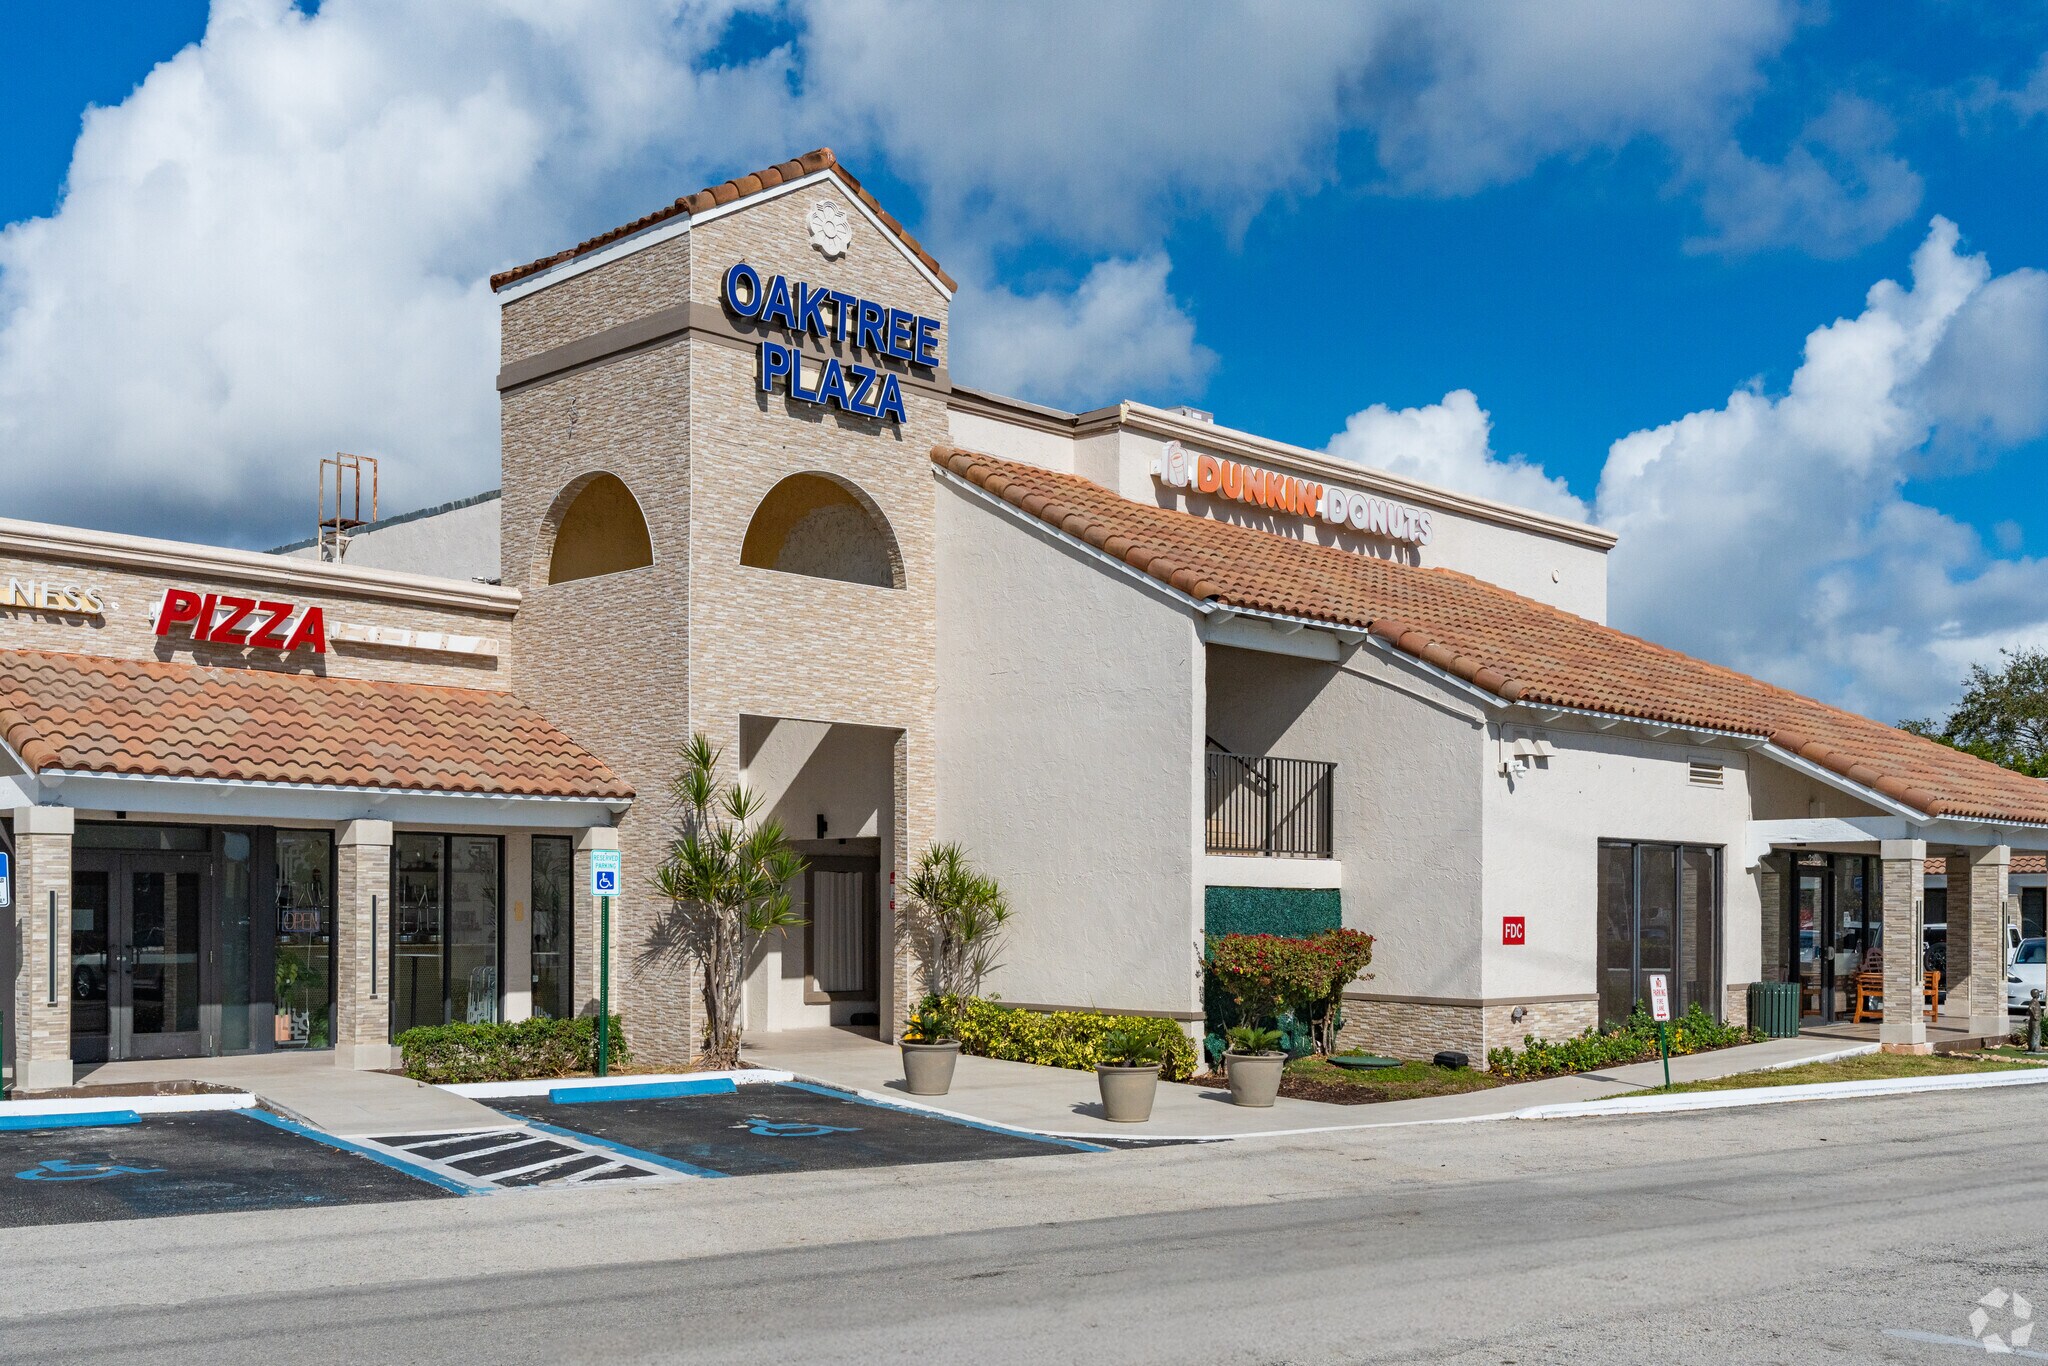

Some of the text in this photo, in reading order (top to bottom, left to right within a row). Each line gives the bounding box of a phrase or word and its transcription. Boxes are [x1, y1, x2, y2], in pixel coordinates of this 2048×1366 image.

[725, 263, 941, 368] OAKTREE
[761, 340, 907, 424] PLAZA
[1195, 454, 1433, 546] DUNKIN' DONUTS
[154, 588, 326, 654] PIZZA
[284, 912, 319, 930] OPEN
[1505, 923, 1523, 938] FDC
[1656, 979, 1662, 987] NO
